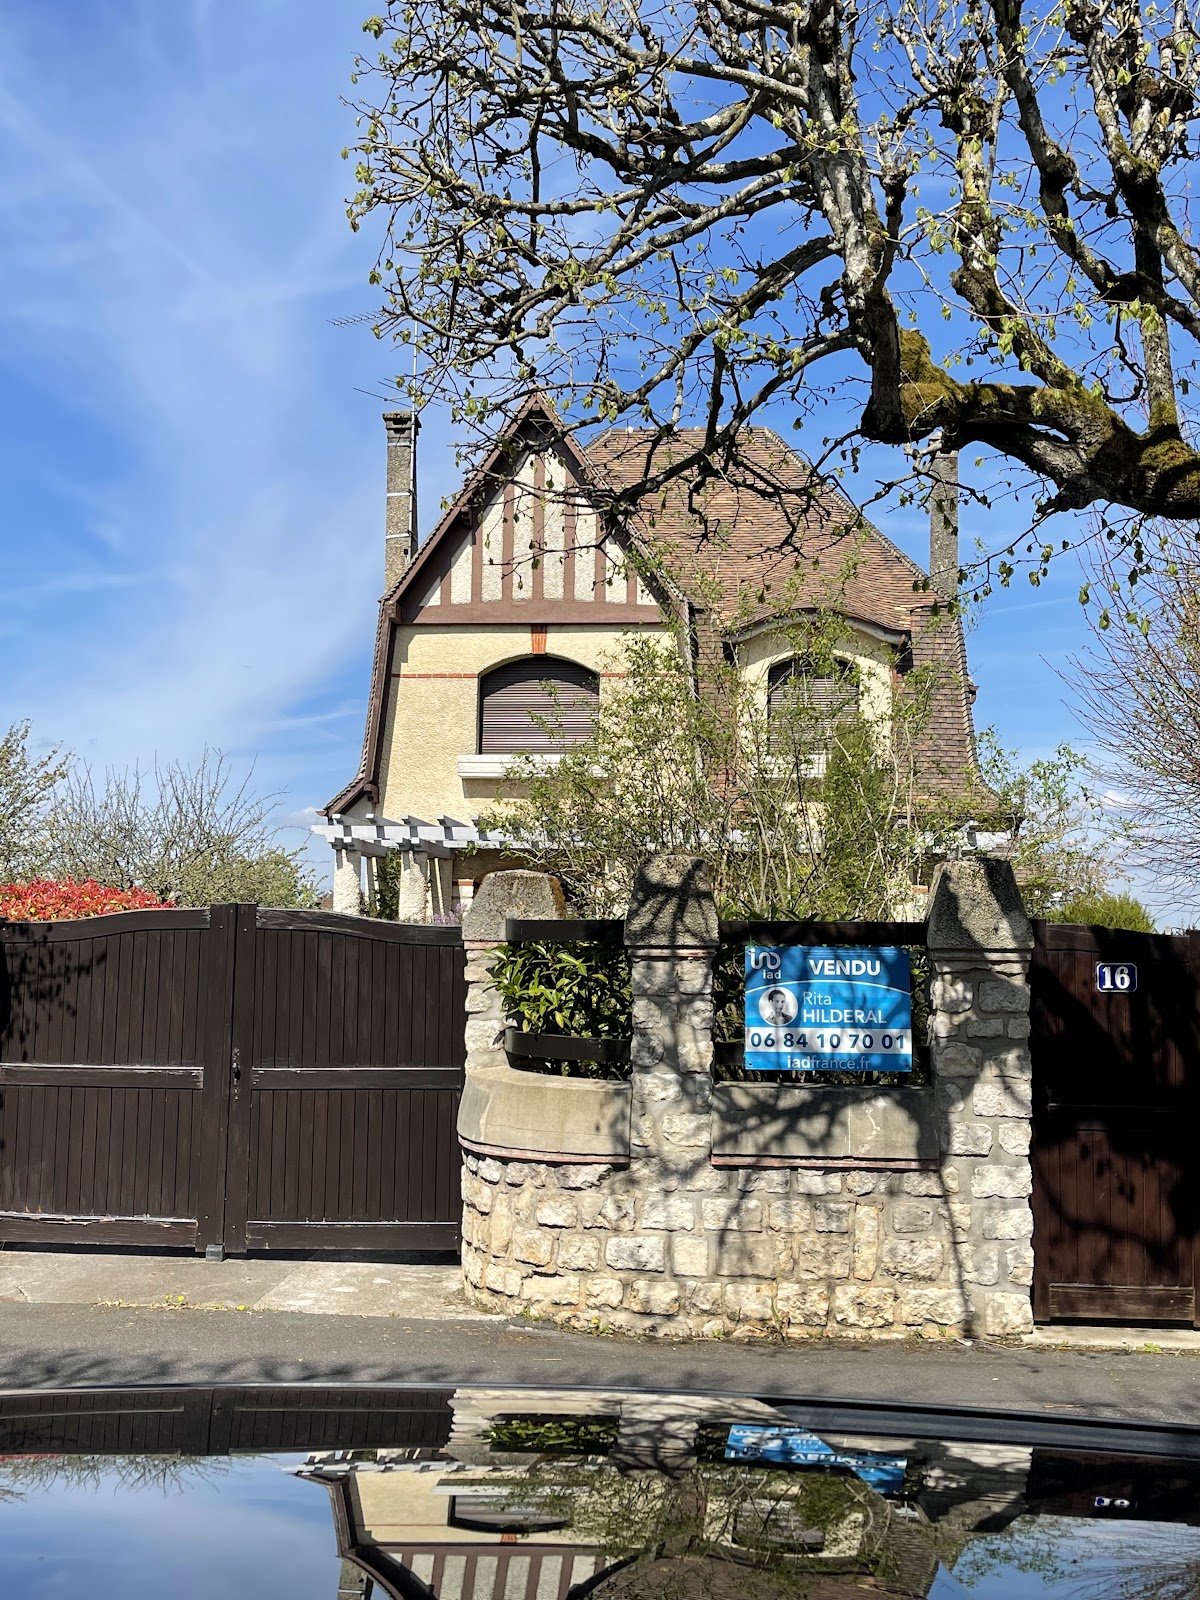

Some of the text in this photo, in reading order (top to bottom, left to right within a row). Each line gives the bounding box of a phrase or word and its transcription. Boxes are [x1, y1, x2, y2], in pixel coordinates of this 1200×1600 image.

[762, 969, 782, 980] iad
[809, 959, 881, 976] VENDU
[1102, 966, 1131, 989] 16
[803, 991, 832, 1006] Rita
[803, 1009, 887, 1024] HILDERAL
[750, 1033, 904, 1049] 06 84 10 70 01
[787, 1055, 871, 1069] iadfrance.fr
